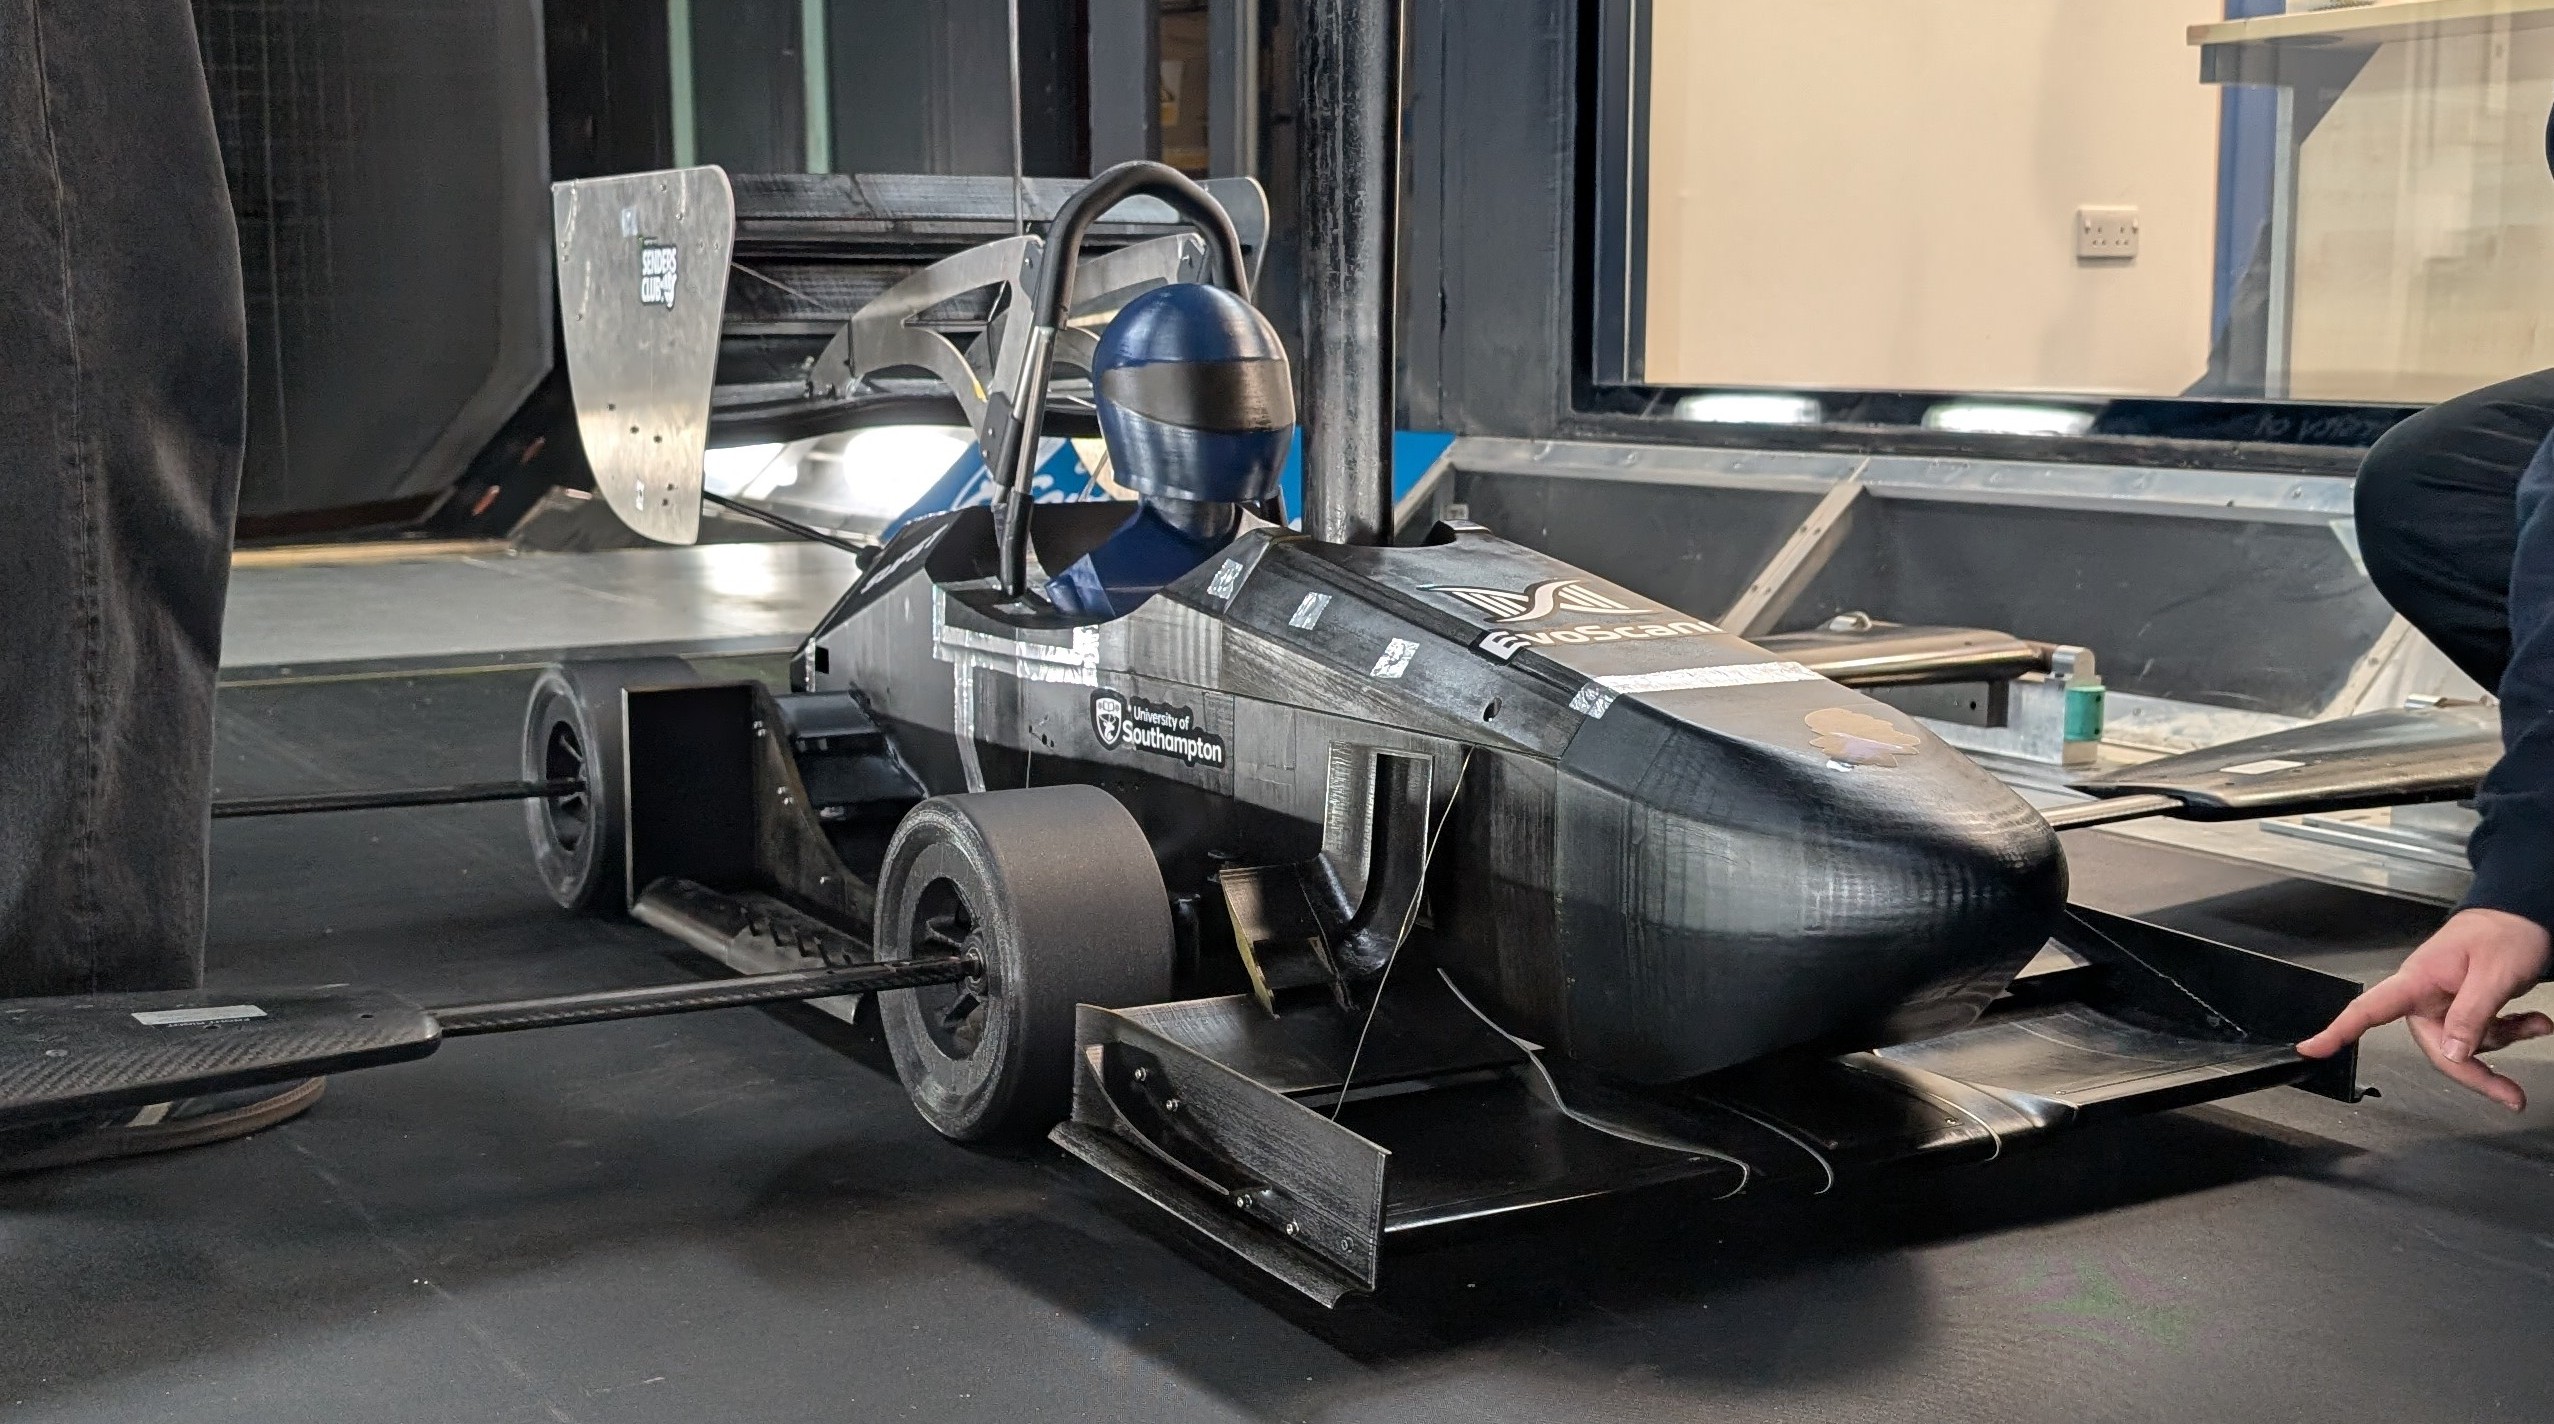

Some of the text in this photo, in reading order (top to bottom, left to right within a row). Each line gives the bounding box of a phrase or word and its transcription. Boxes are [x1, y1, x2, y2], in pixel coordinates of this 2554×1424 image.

[643, 247, 677, 274] SENDERS
[1133, 705, 1190, 731] University of
[1121, 719, 1223, 763] Southampton
